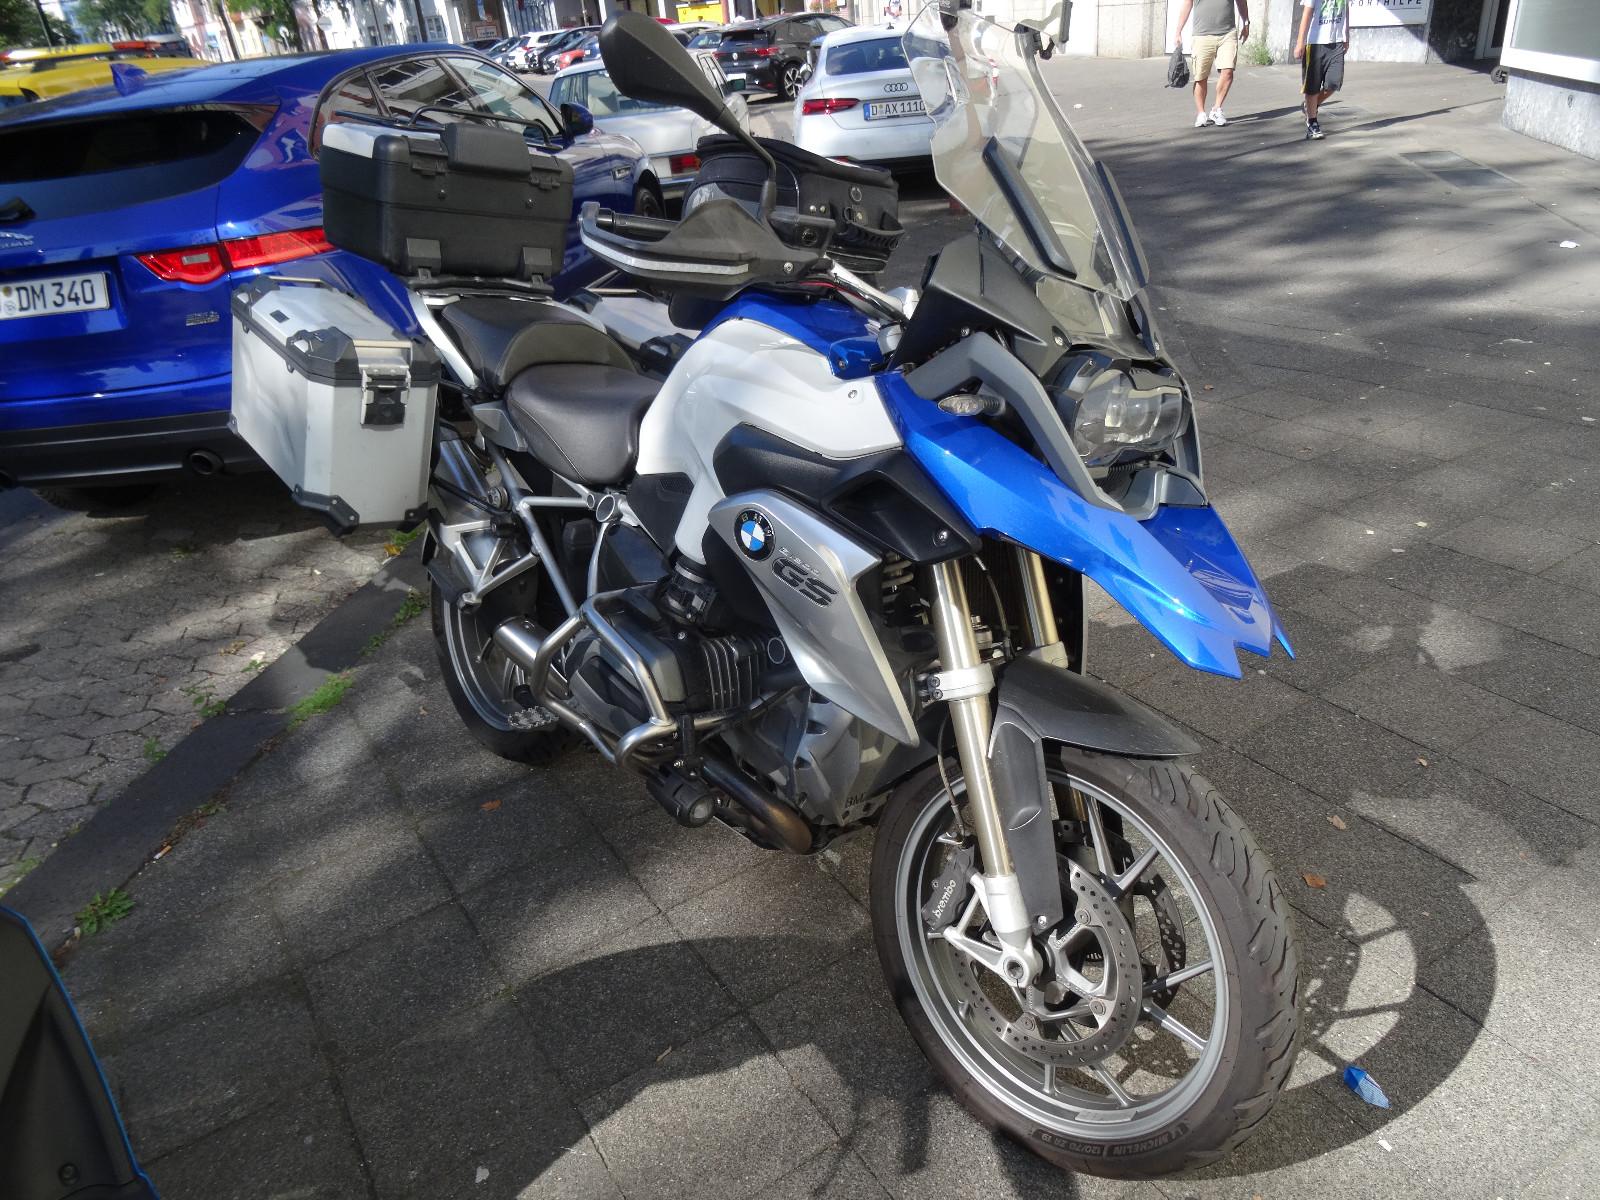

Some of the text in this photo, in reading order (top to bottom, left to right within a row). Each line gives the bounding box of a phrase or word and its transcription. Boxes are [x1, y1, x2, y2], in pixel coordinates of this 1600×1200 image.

[885, 103, 898, 115] AX
[16, 278, 96, 313] DM 340
[772, 557, 838, 608] GS
[932, 879, 957, 919] brembo
[1112, 1134, 1169, 1156] MICHELIN
